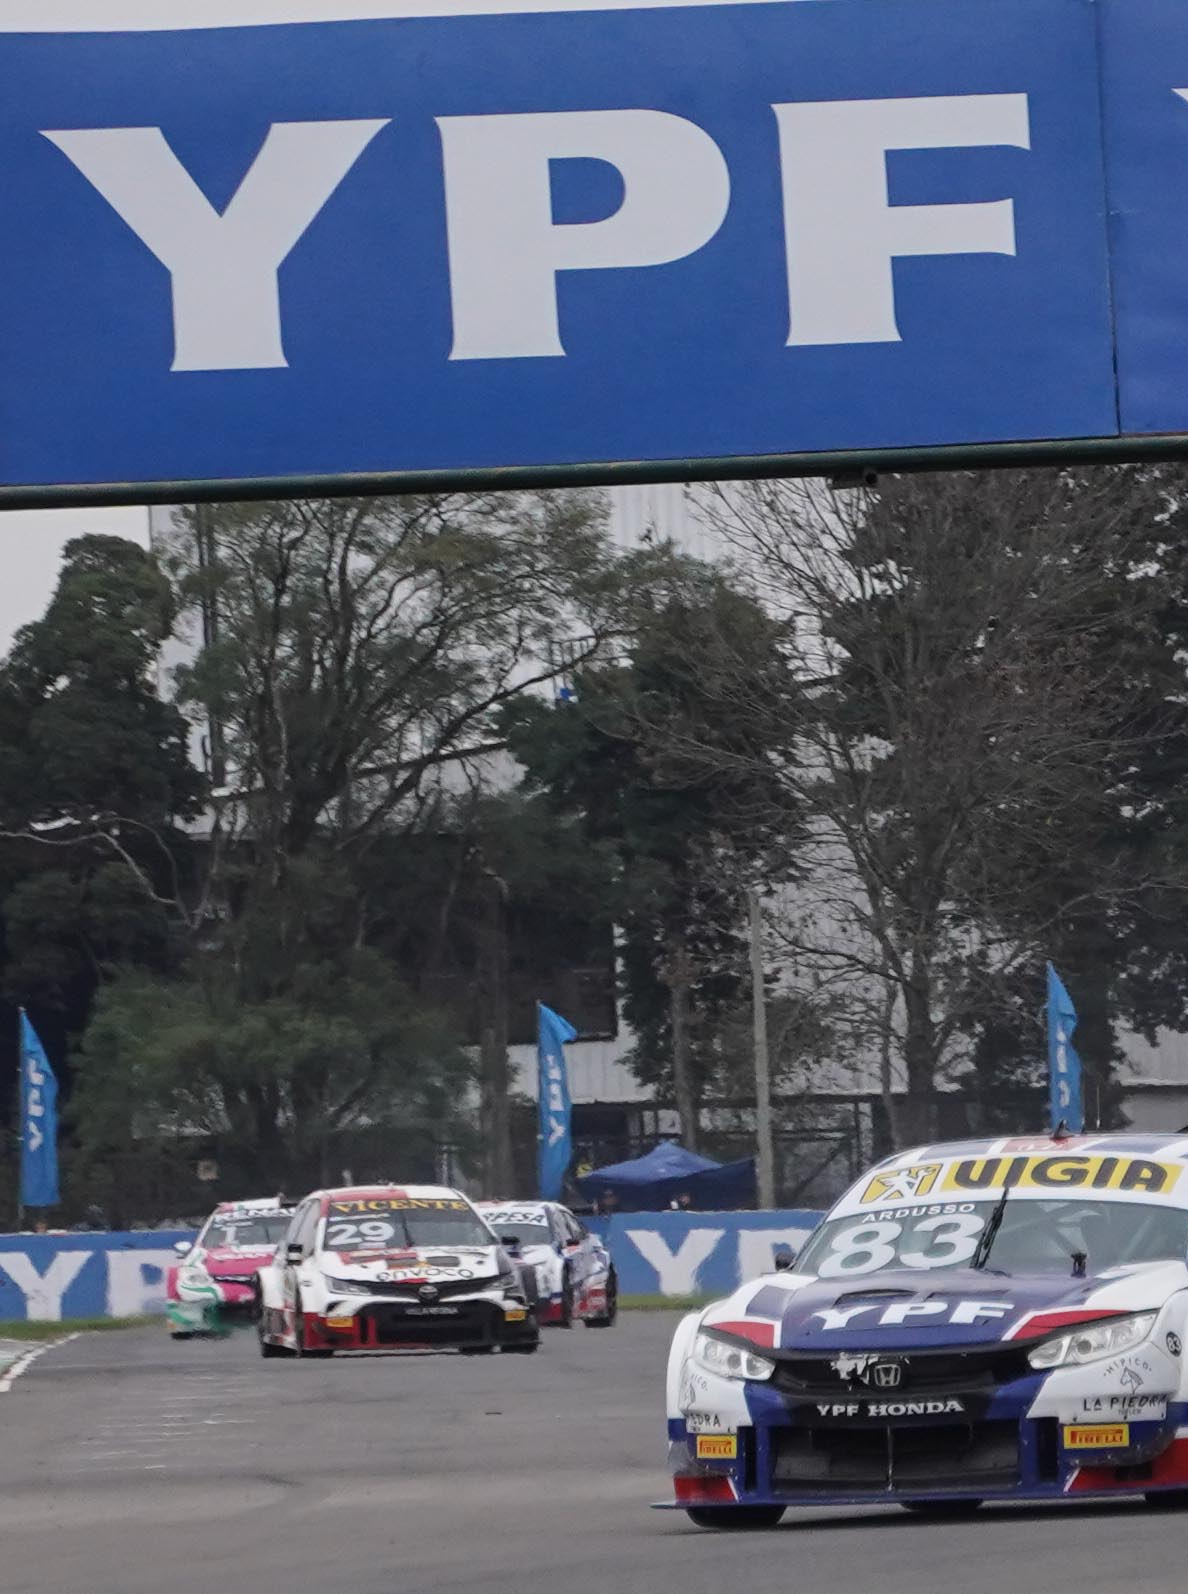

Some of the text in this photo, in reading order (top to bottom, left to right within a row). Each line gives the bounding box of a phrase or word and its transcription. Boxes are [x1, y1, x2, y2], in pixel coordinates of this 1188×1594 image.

[38, 92, 1031, 371] YPF
[333, 1199, 470, 1213] VICENTE
[861, 1203, 976, 1224] ARDUSSO
[326, 1221, 396, 1246] 29
[817, 1213, 986, 1278] 83
[0, 1249, 187, 1322] YP
[812, 1301, 1015, 1331] YPF
[817, 1401, 965, 1416] YPF HONDA
[1083, 1398, 1102, 1411] LA
